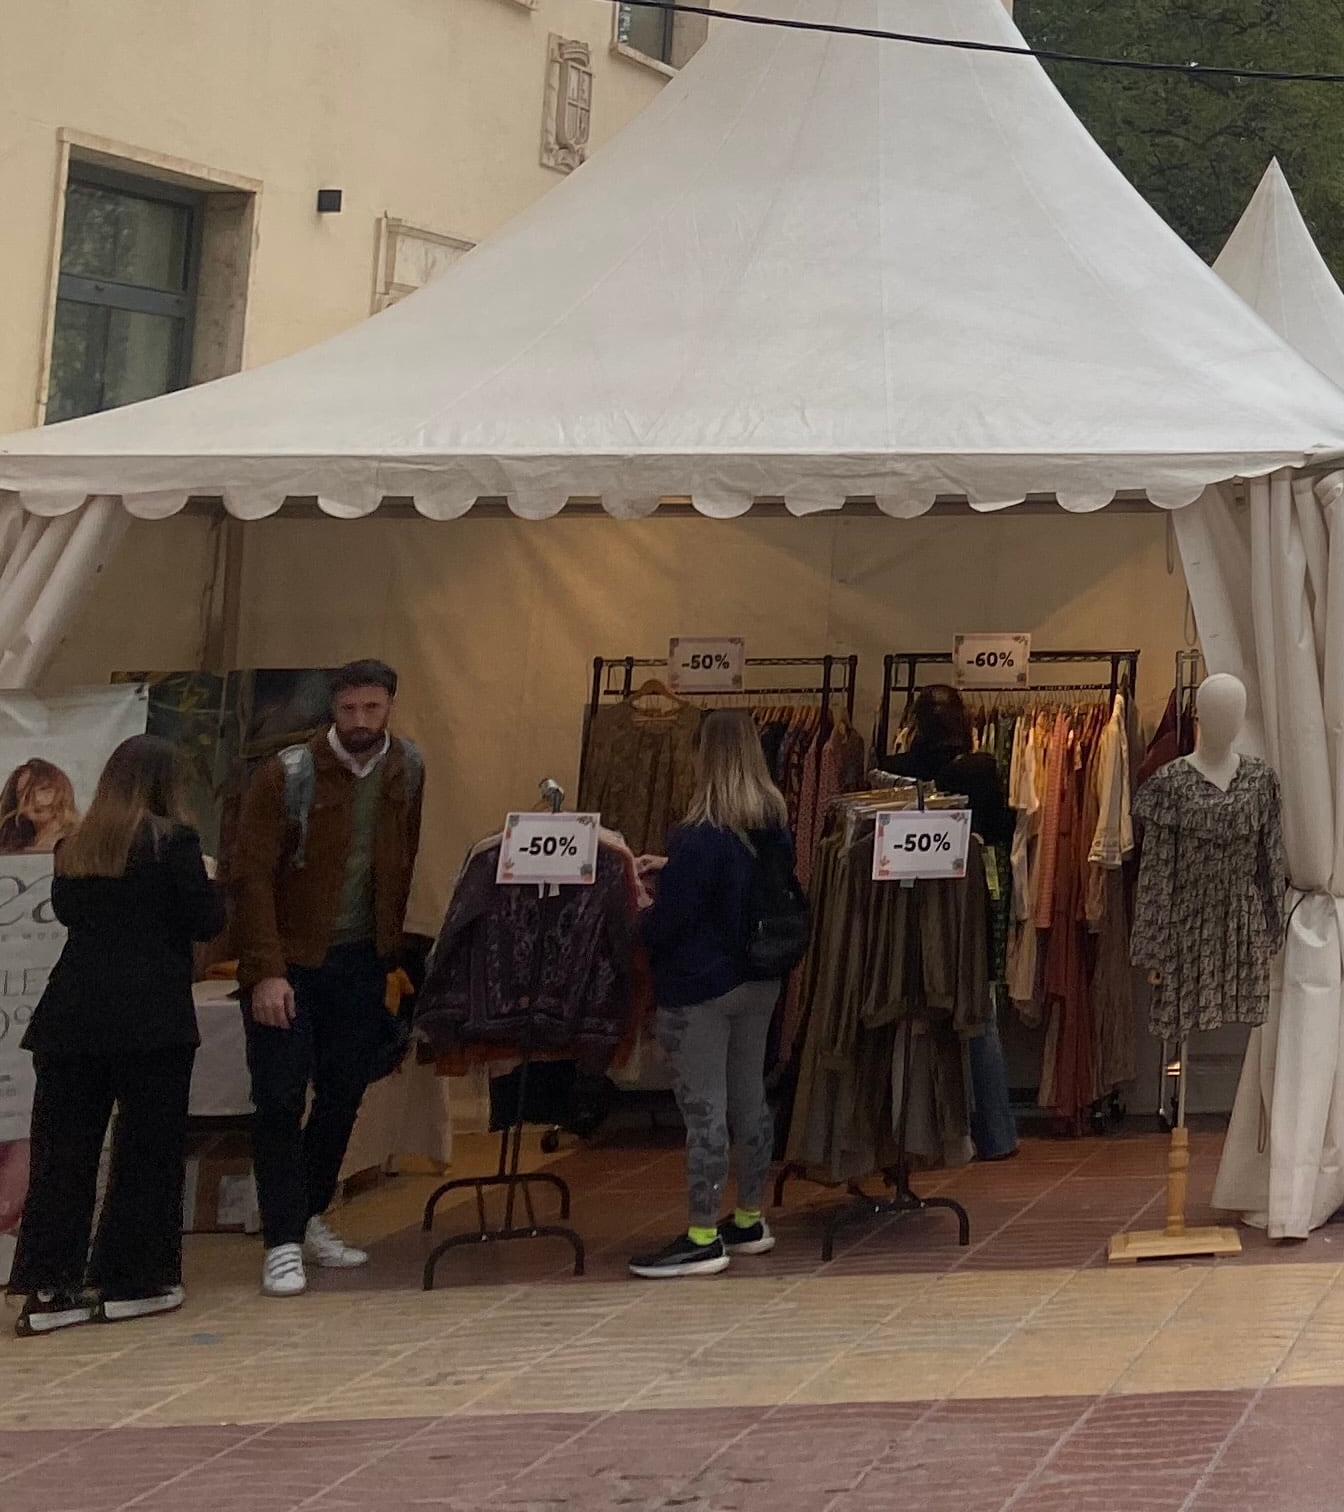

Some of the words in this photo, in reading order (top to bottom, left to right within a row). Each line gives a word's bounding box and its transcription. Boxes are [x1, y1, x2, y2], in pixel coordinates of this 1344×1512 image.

[681, 653, 730, 669] -50%
[966, 651, 1014, 668] -60%
[518, 834, 577, 857] -50%
[893, 831, 951, 853] -50%
